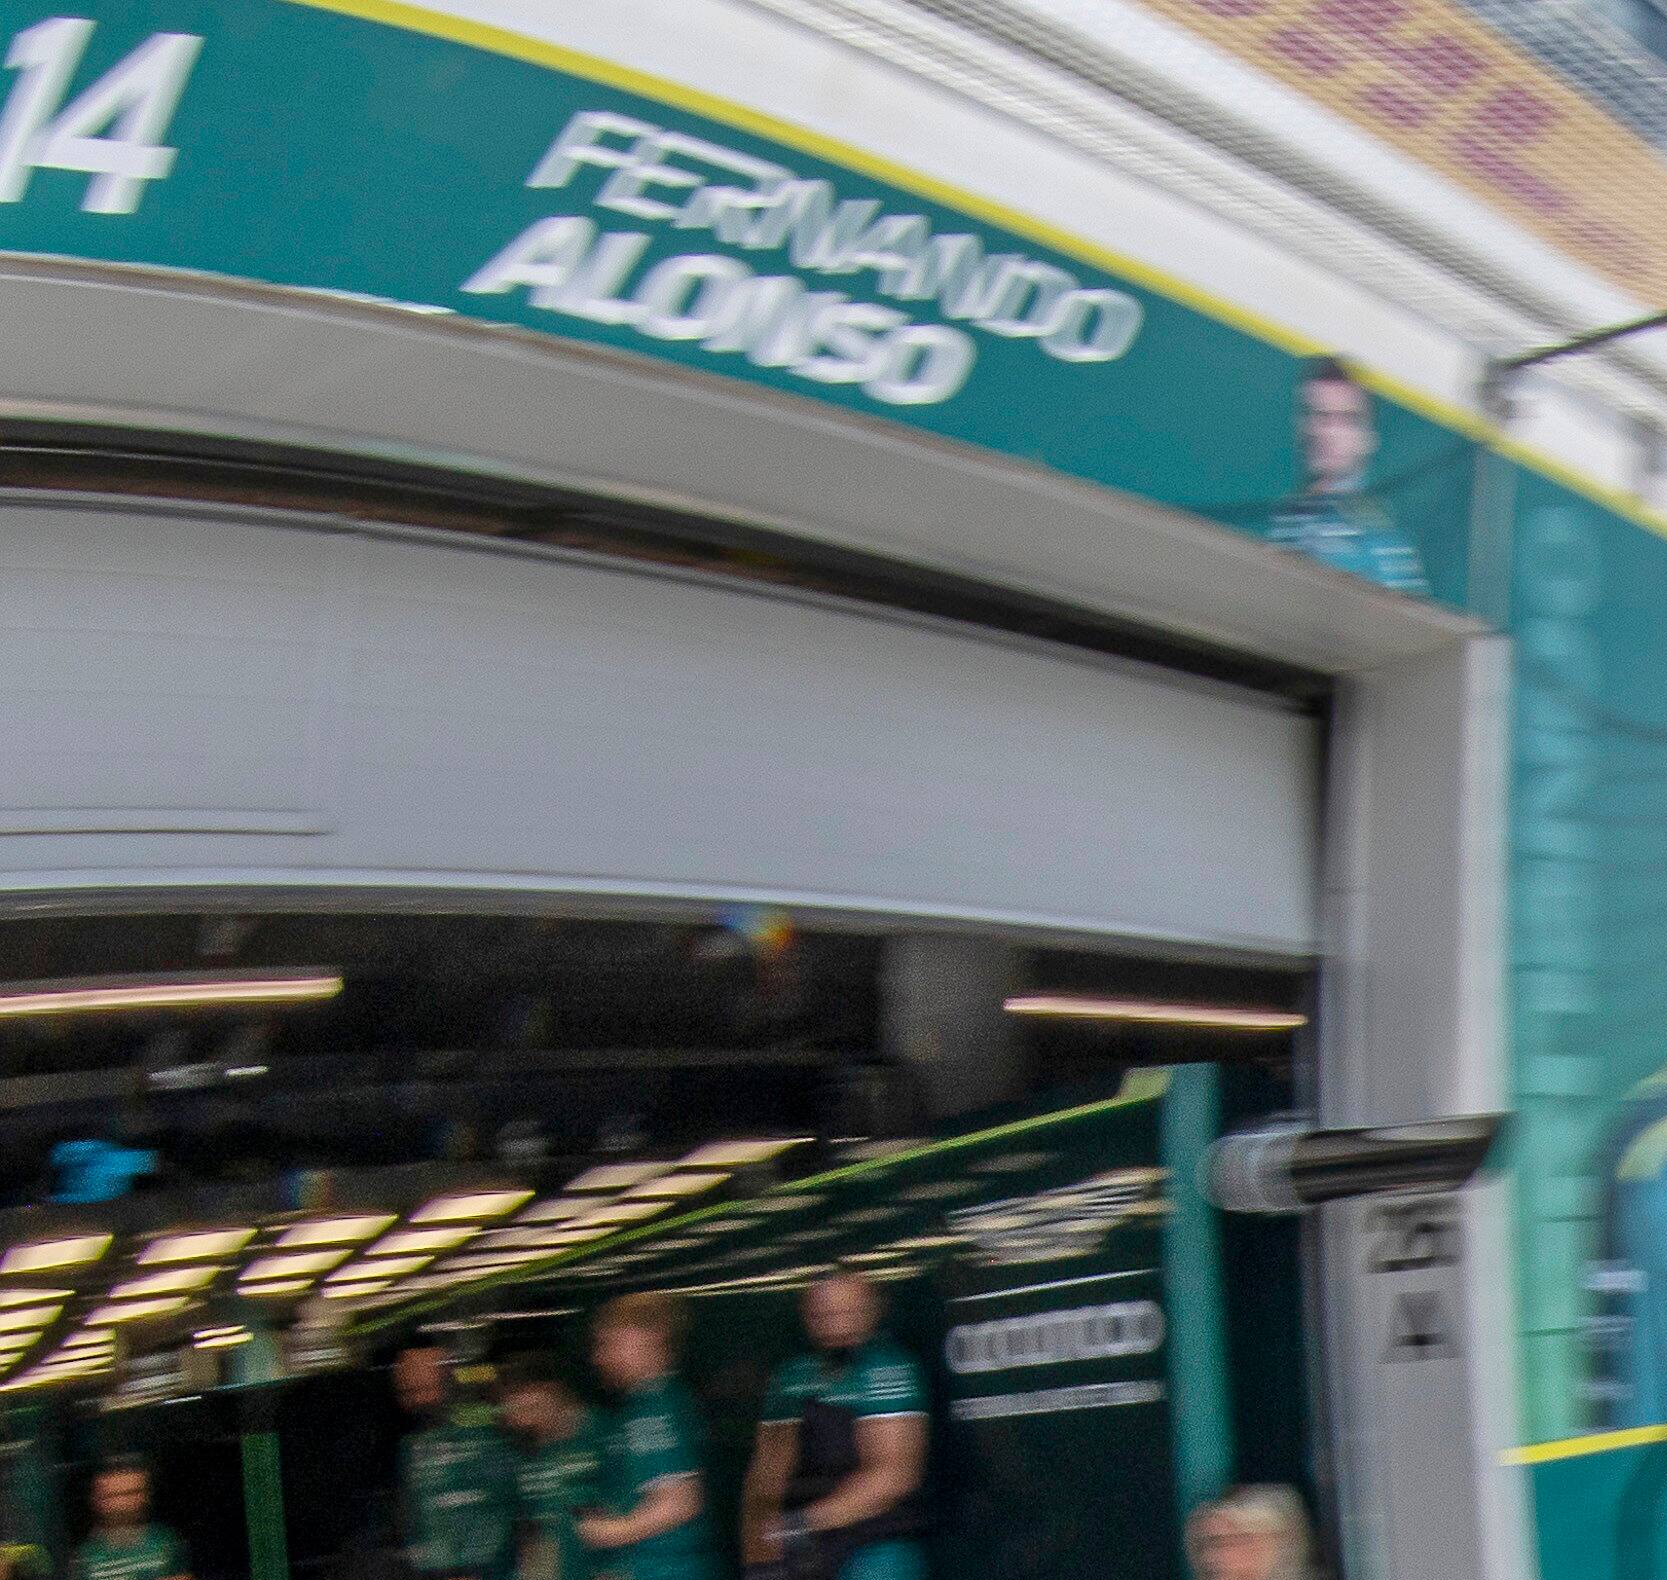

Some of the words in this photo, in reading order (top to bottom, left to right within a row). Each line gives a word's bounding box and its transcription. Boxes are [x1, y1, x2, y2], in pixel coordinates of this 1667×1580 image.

[0, 17, 204, 214] 14
[460, 215, 975, 404] ALONSO
[527, 110, 1143, 363] FERNANDO
